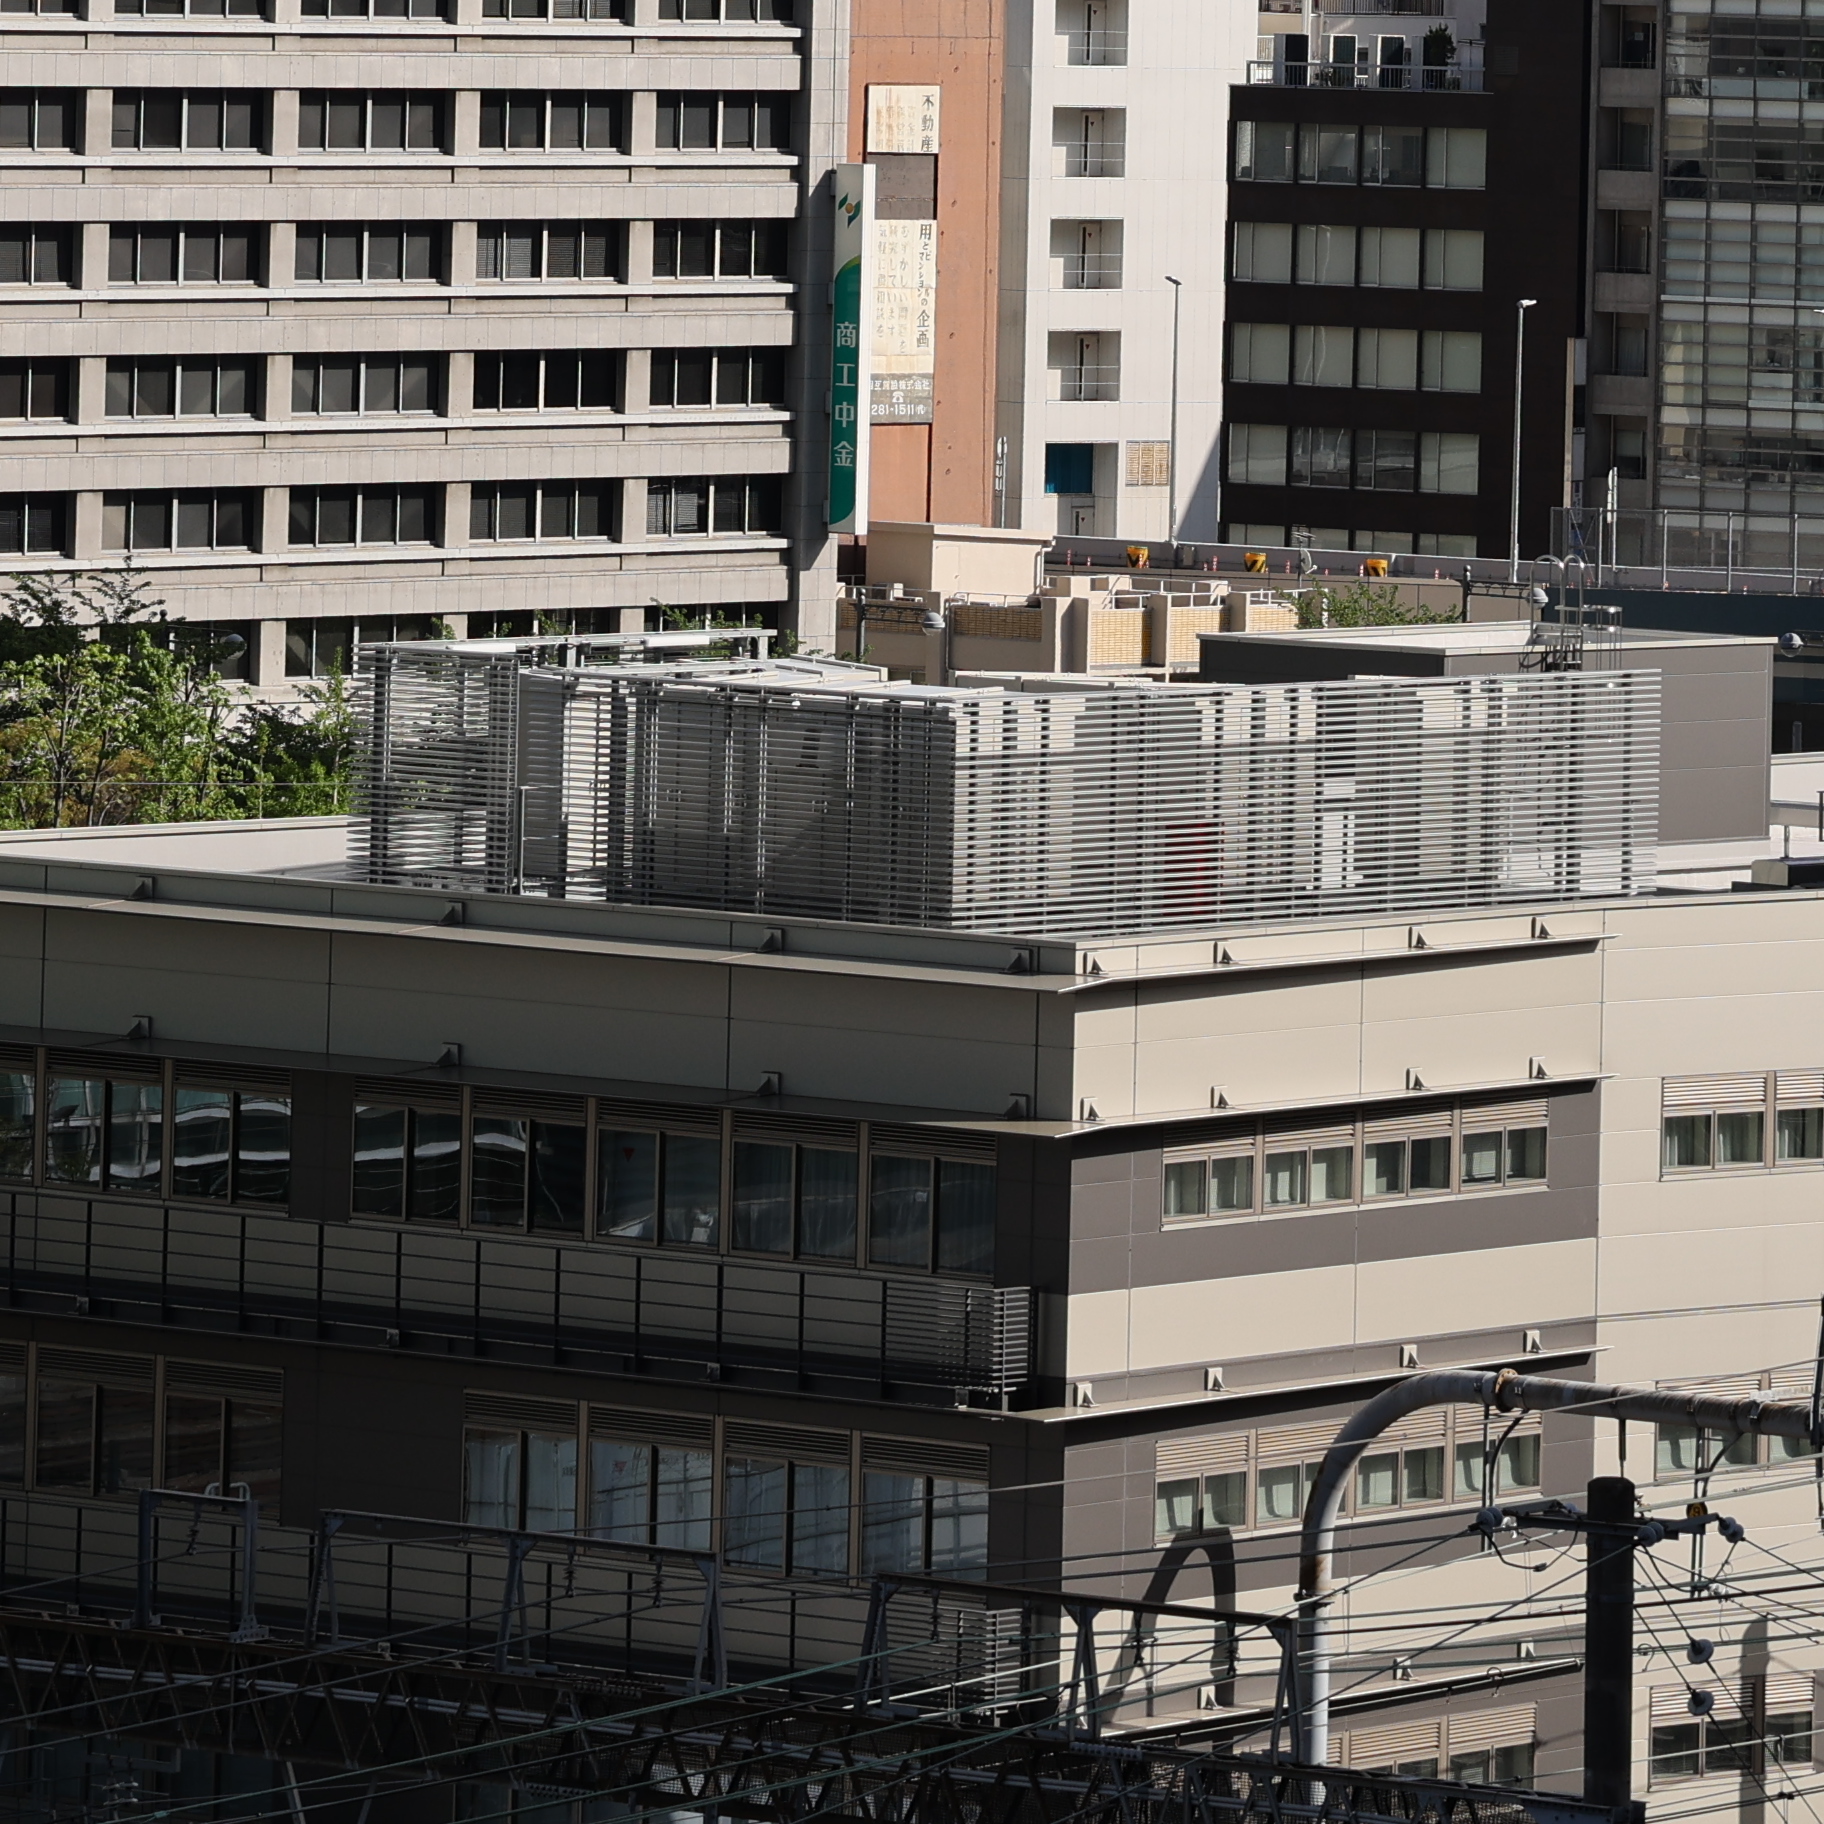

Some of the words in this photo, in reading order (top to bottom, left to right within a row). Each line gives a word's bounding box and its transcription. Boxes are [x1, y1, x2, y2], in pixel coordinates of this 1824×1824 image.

[920, 94, 935, 153] 不動産
[833, 321, 857, 467] 商工中金
